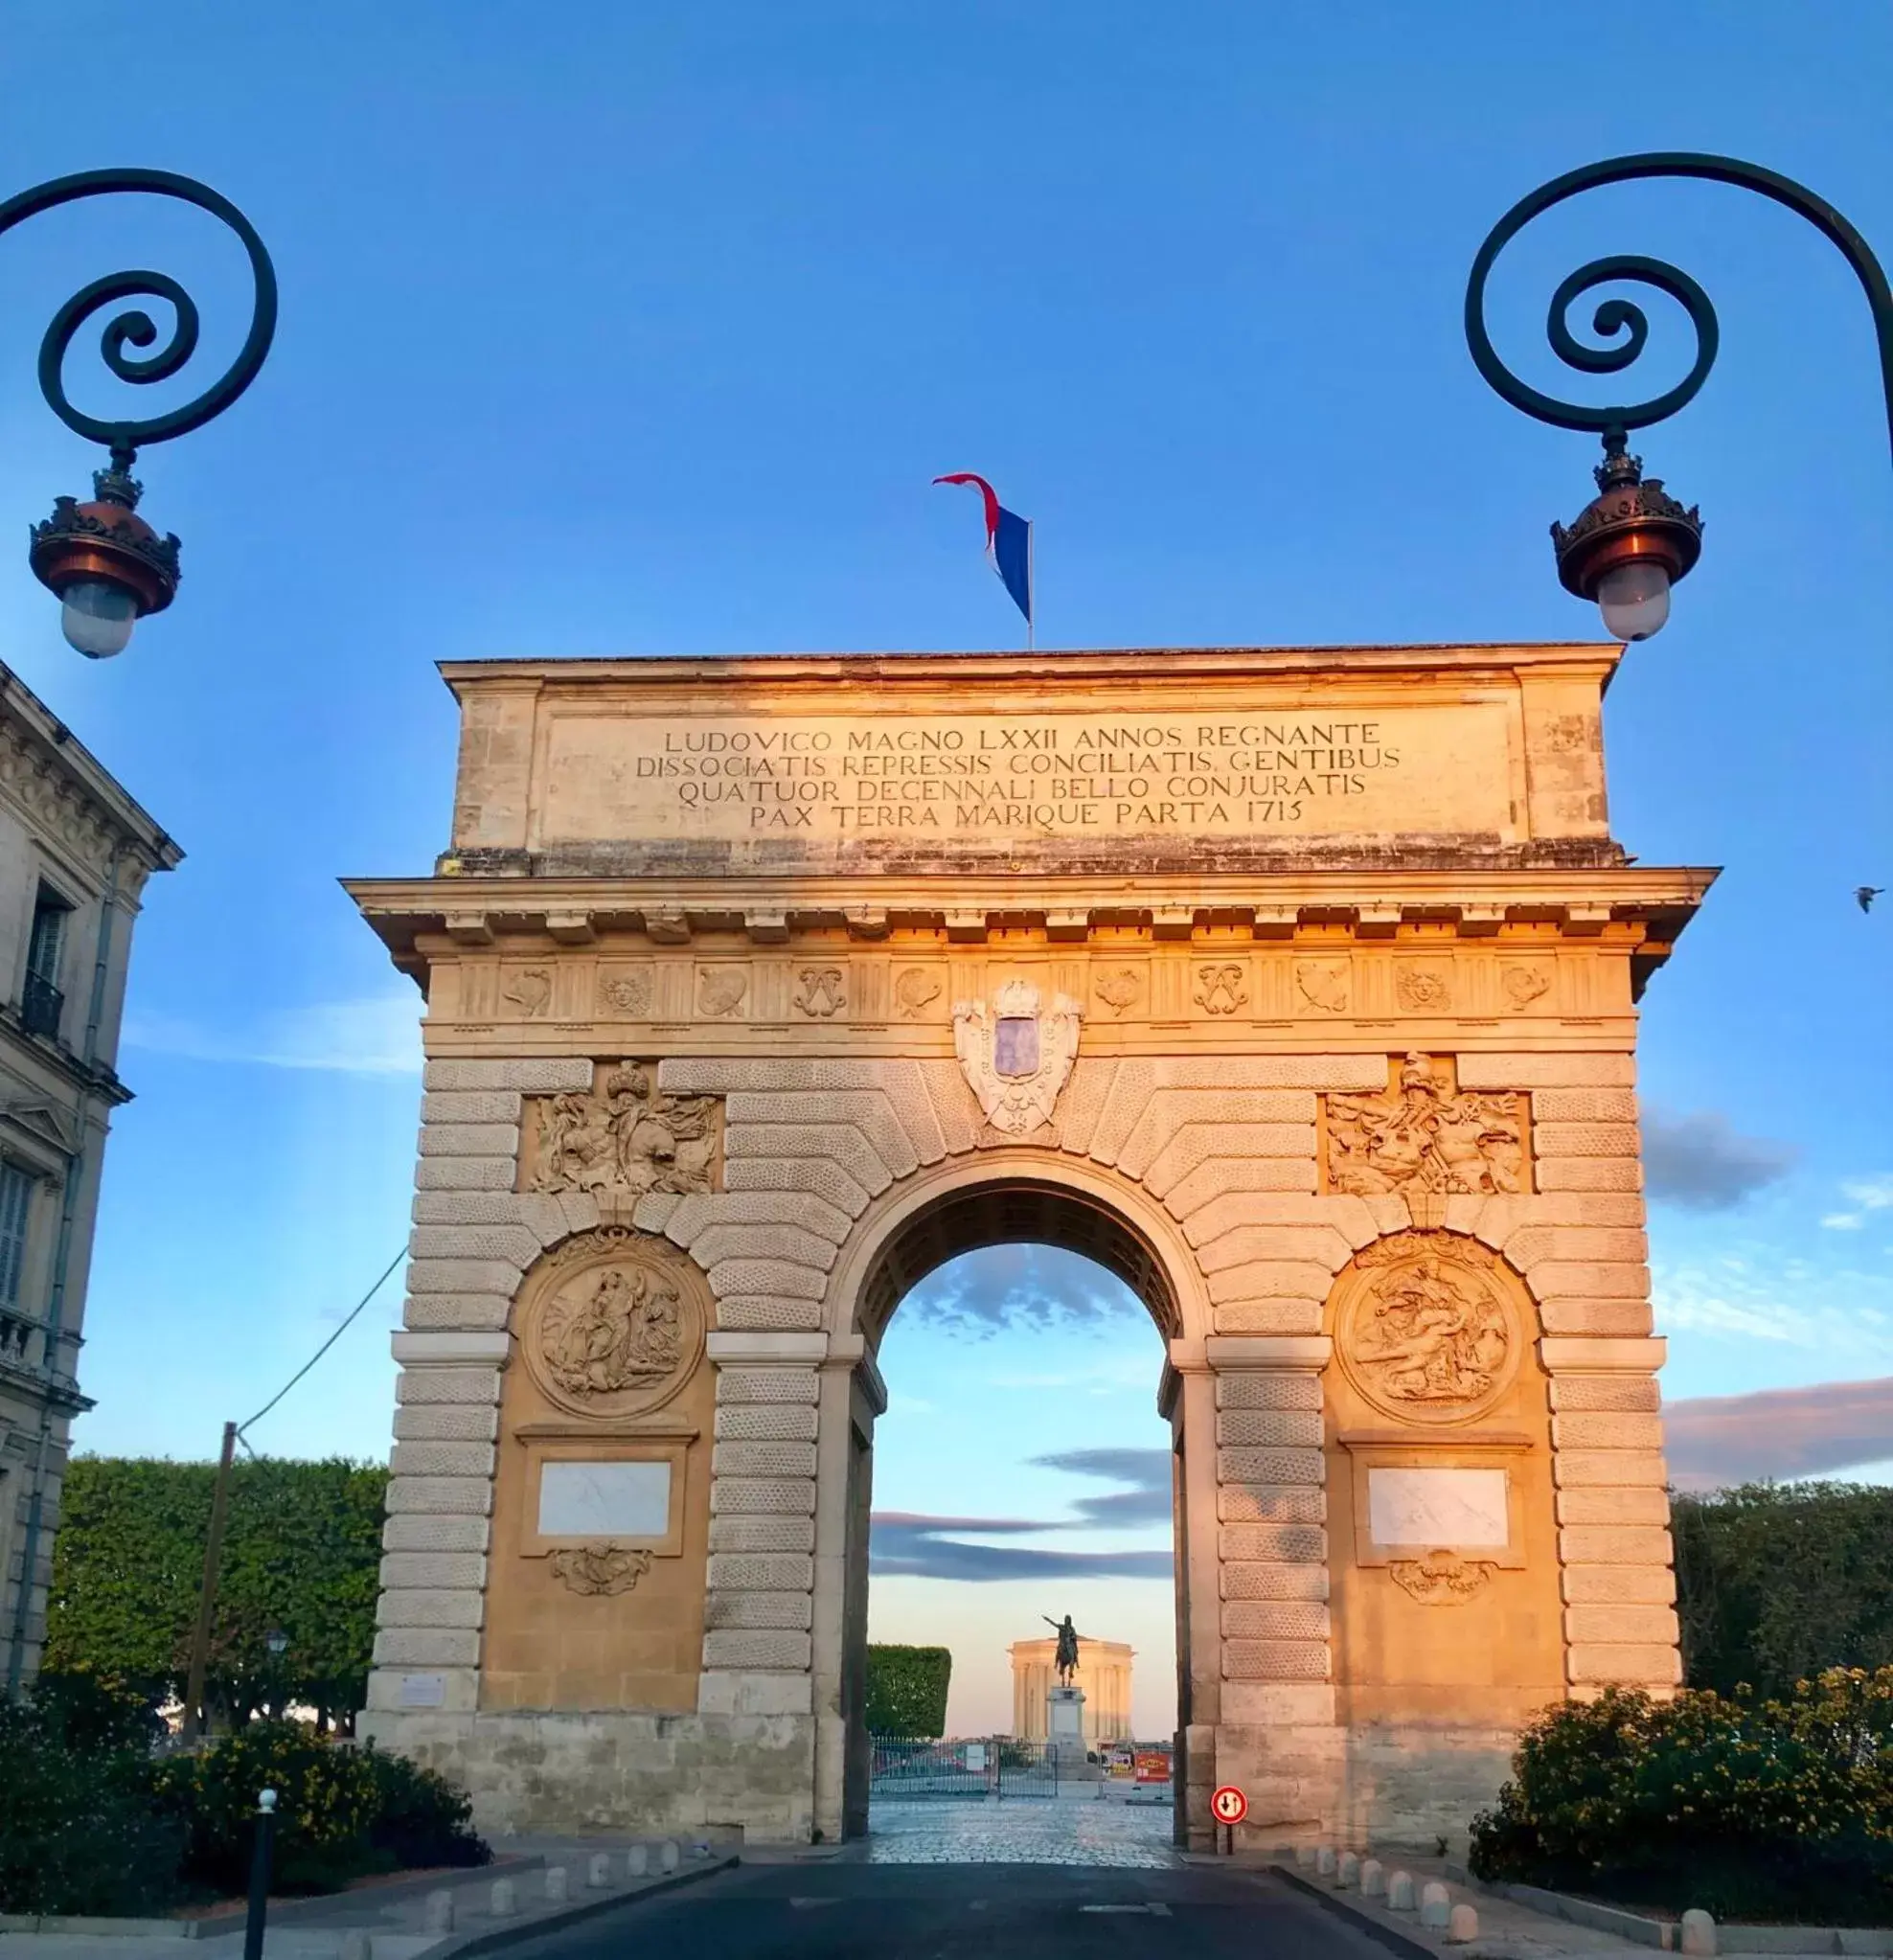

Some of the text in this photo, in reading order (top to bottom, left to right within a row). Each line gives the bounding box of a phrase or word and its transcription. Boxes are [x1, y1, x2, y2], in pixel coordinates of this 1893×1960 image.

[666, 723, 1380, 752] LUDOVICO MAGNO LXXII ANNOS REGNANTE
[636, 756, 826, 778] DISSOCIATIS
[843, 754, 992, 776] REPRESSIS
[1229, 747, 1400, 771] GENTIBUS
[678, 774, 1366, 808] QUATUOR DECENNALI BELLO CONJURATIS
[750, 800, 1303, 831] PAX TERRA MARIQUE PARTA 1715
